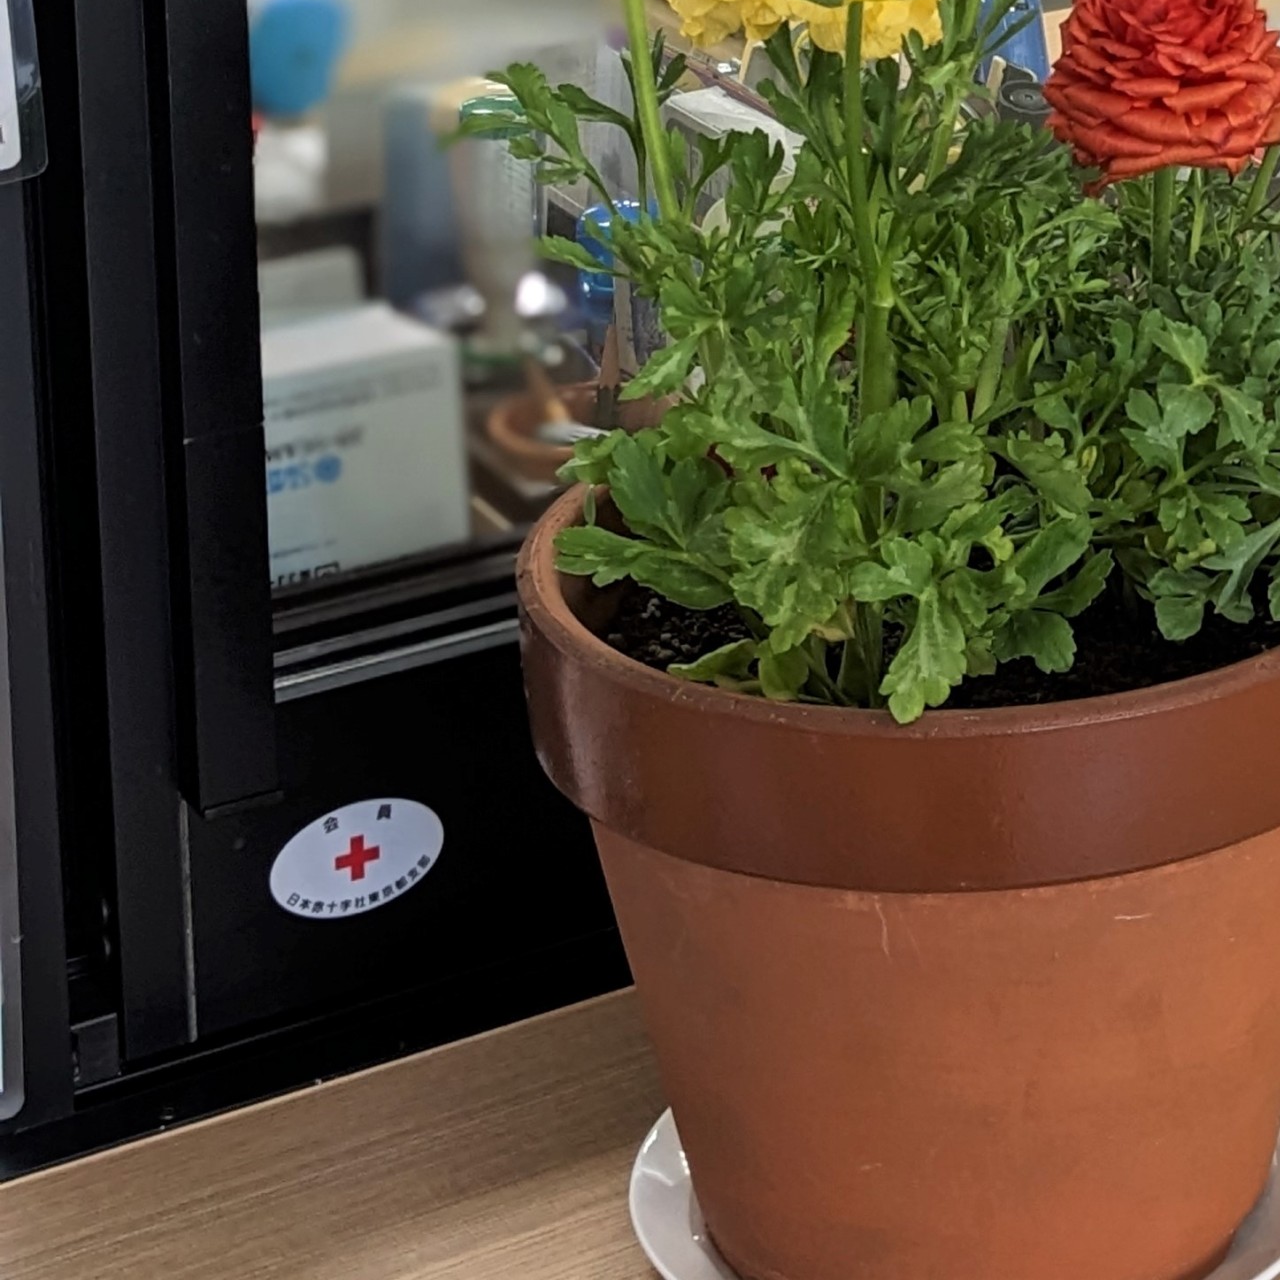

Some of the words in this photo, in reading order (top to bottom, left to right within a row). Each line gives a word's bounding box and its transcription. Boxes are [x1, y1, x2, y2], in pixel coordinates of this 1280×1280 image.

[286, 854, 431, 913] 日本赤十字社東京都支部
